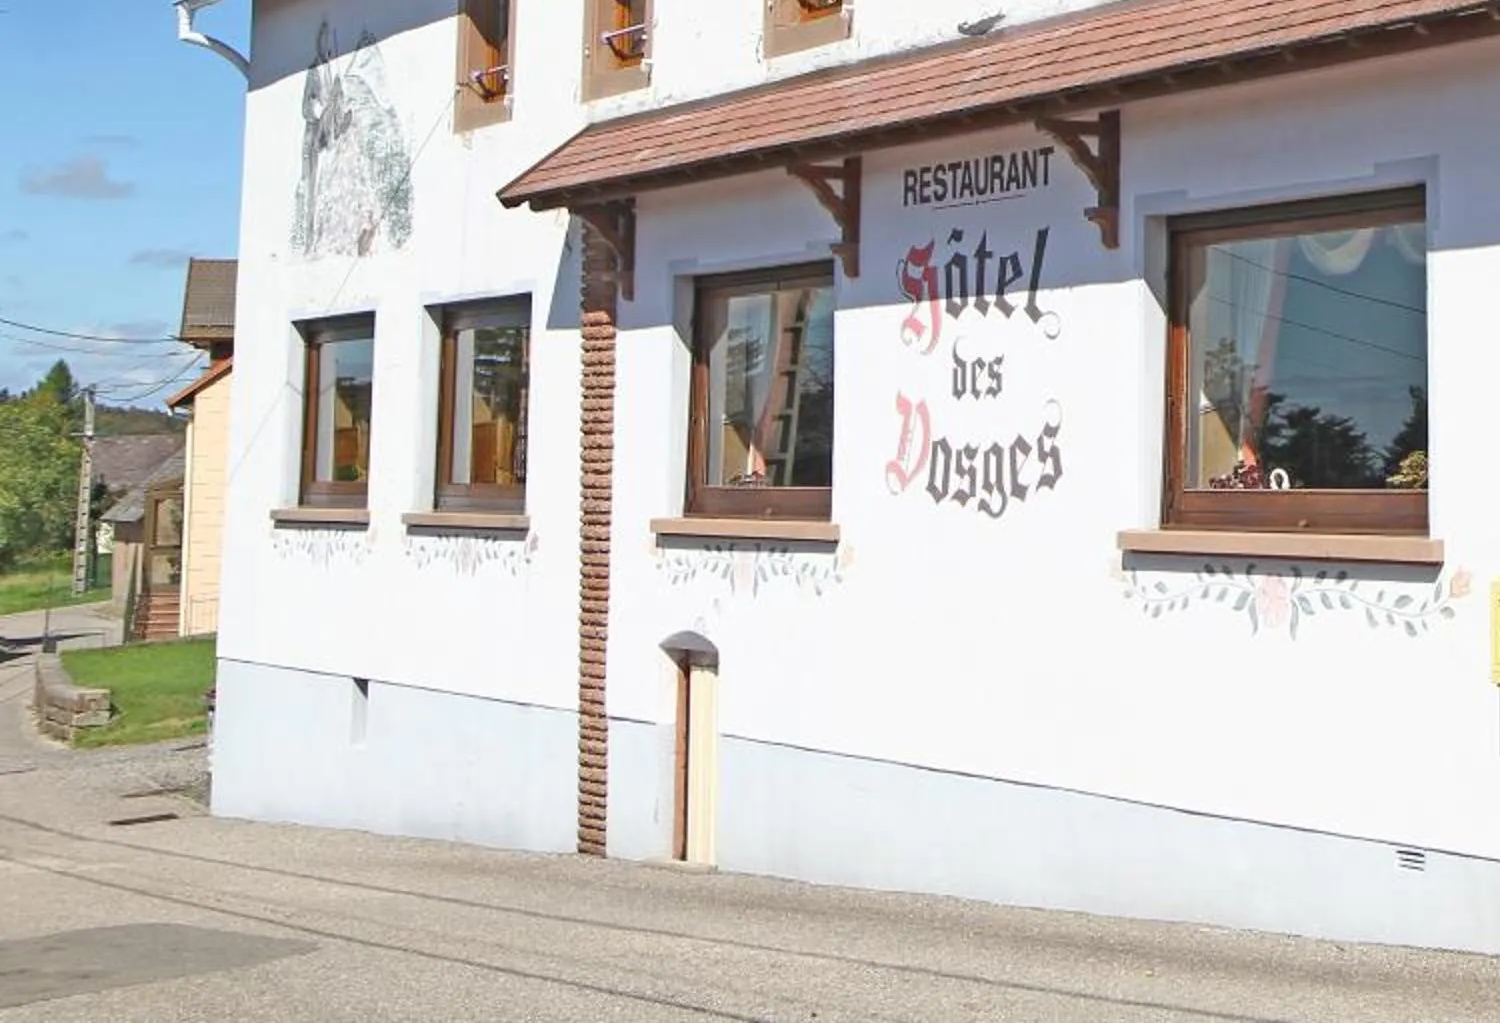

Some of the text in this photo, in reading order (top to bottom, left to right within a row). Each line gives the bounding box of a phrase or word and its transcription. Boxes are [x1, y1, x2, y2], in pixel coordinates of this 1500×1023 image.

[903, 147, 1055, 207] RESTAURANT
[896, 225, 1062, 355] Hôtel
[952, 336, 1005, 400] des
[886, 390, 1064, 519] Vosges
